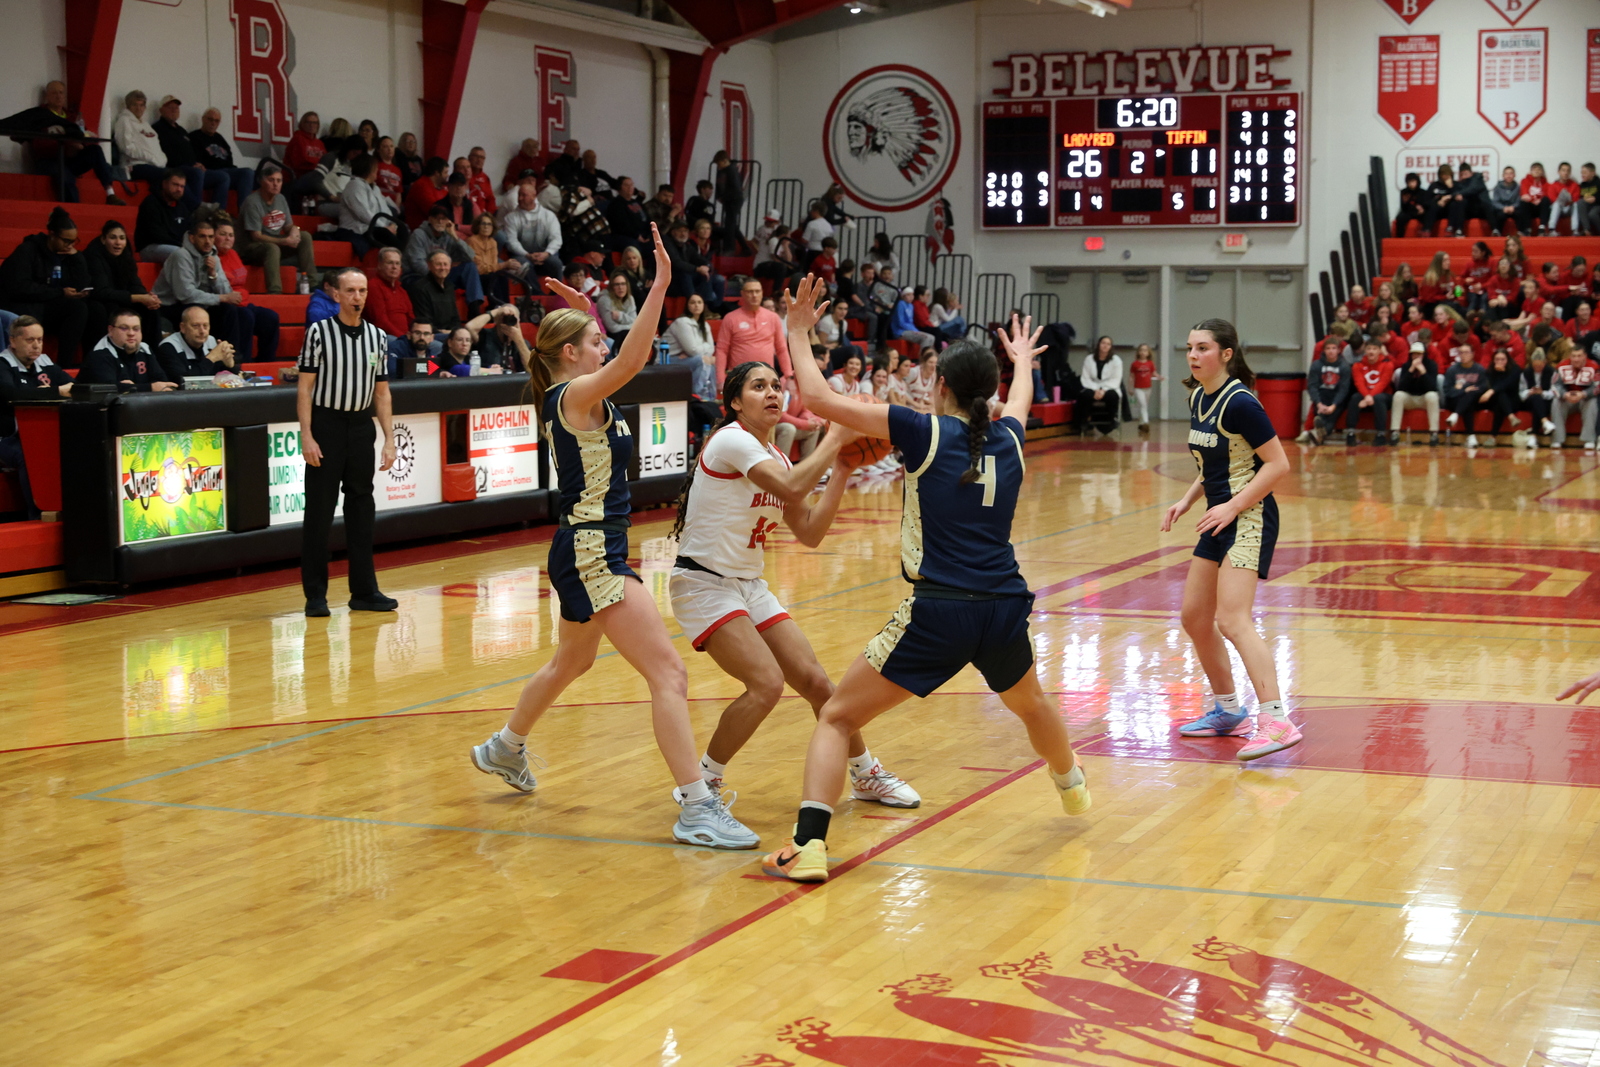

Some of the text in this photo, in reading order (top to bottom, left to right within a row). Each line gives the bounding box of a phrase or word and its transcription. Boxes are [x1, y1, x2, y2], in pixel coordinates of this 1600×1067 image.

[229, 0, 294, 145] R
[1009, 46, 1275, 98] BELLEVUE
[1117, 98, 1177, 127] 6:20
[1241, 109, 1296, 128] 3 1 2
[1503, 111, 1520, 130] B
[1399, 113, 1416, 132] B
[1064, 132, 1115, 148] LADYRED
[1122, 139, 1152, 149] PERIOD
[1165, 130, 1208, 145] TIFFIN
[1240, 129, 1296, 146] 4 1 4
[1067, 149, 1102, 178] 26
[1130, 151, 1145, 174] 2
[1191, 148, 1216, 174] 11
[1256, 148, 1268, 166] 0
[1283, 147, 1296, 165] 0
[1405, 155, 1490, 168] BELLEVUE
[1011, 171, 1023, 189] 0
[1037, 171, 1049, 187] 9
[1191, 177, 1218, 187] FOULS
[1234, 166, 1295, 183] 14 1 2
[1057, 180, 1083, 190] FOULS
[1111, 178, 1165, 189] PLAYER FOUL
[987, 189, 1049, 207] 32 0 3
[1074, 191, 1081, 211] 1
[1172, 192, 1184, 210] 5
[1209, 188, 1216, 209] 1
[1261, 186, 1268, 202] 1
[1284, 184, 1295, 202] 3
[1090, 195, 1103, 210] 4
[1016, 209, 1023, 223] 1
[1057, 215, 1084, 225] SCORE
[1122, 214, 1150, 224] MATCH
[1190, 214, 1217, 223] SCORE
[1261, 205, 1268, 220] 1
[136, 361, 147, 374] B
[1364, 369, 1381, 384] C
[472, 410, 529, 431] LAUGHLIN
[386, 485, 401, 493] Rotary
[491, 476, 532, 488] Custom Homes
[970, 455, 996, 507] 4
